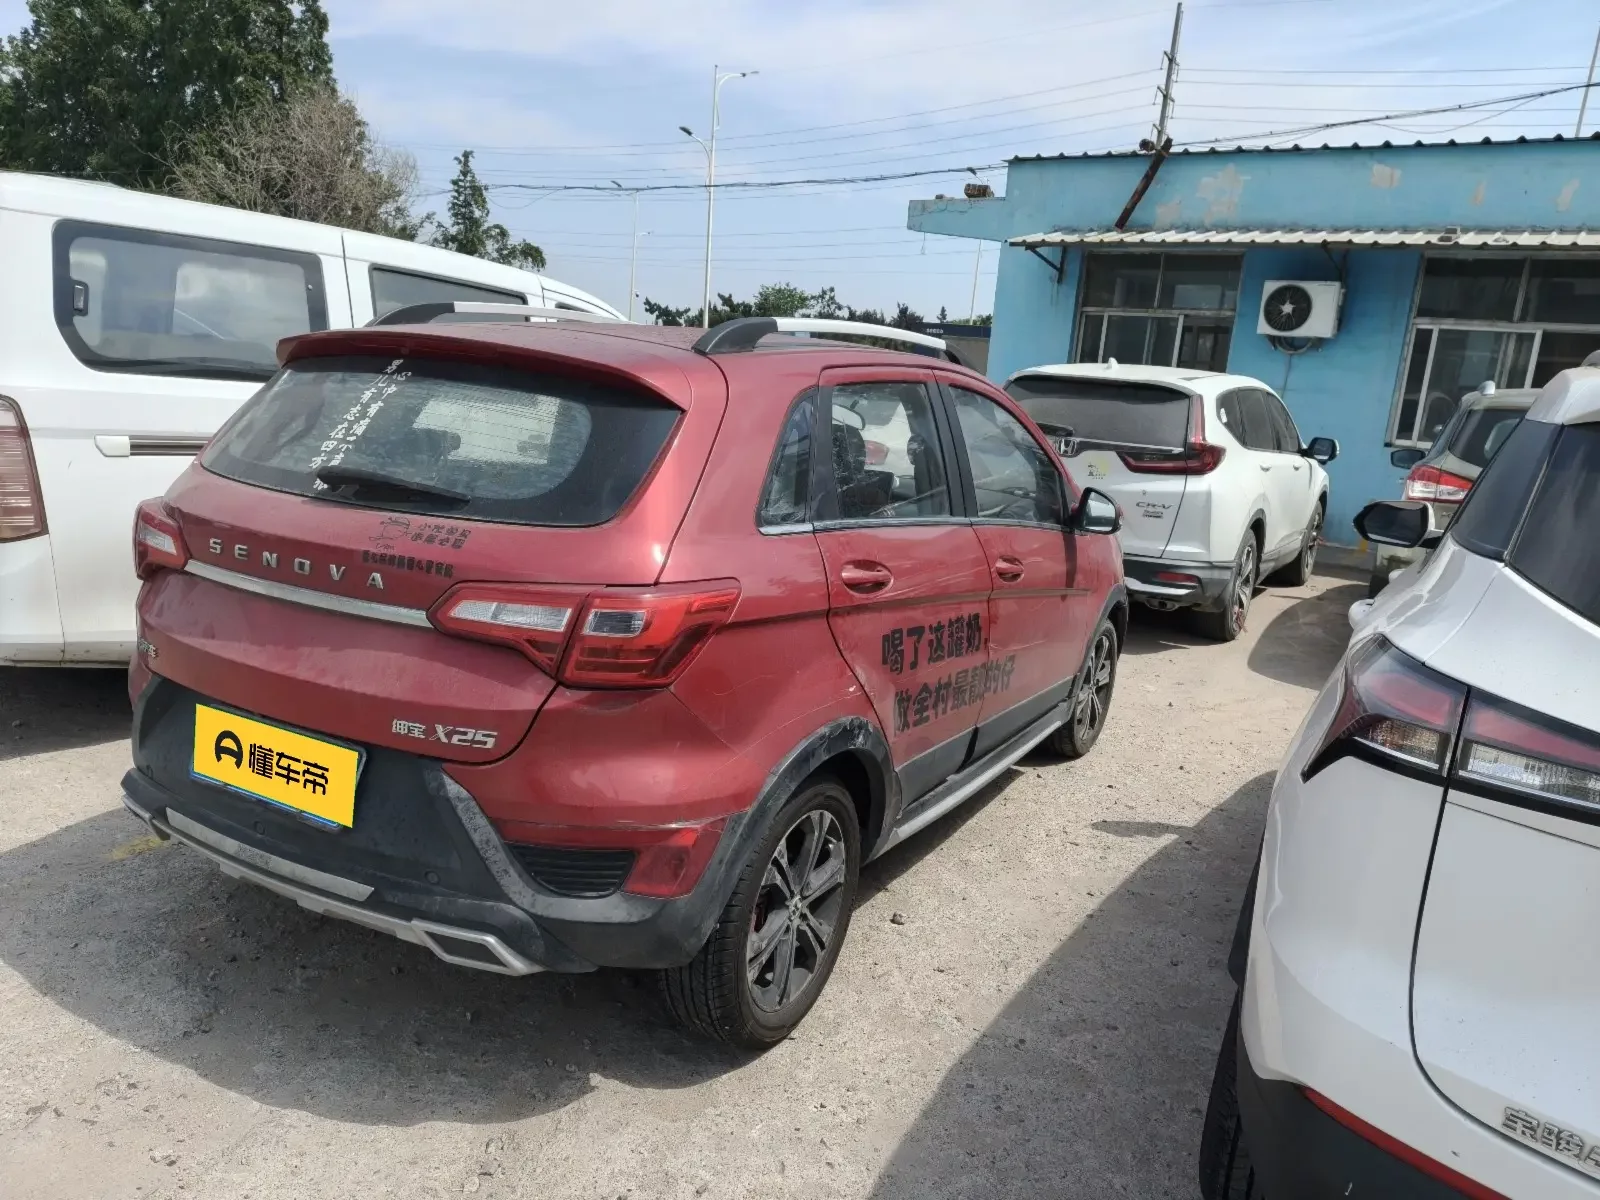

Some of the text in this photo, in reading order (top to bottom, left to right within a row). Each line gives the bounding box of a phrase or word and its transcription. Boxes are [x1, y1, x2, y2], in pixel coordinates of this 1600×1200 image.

[309, 359, 404, 469] 男儿有志在四方
[1135, 501, 1173, 510] CR-V
[209, 537, 385, 590] SENOVA
[893, 654, 1017, 738] 做全村最靓的仔
[392, 718, 498, 749] 绅宝 X25
